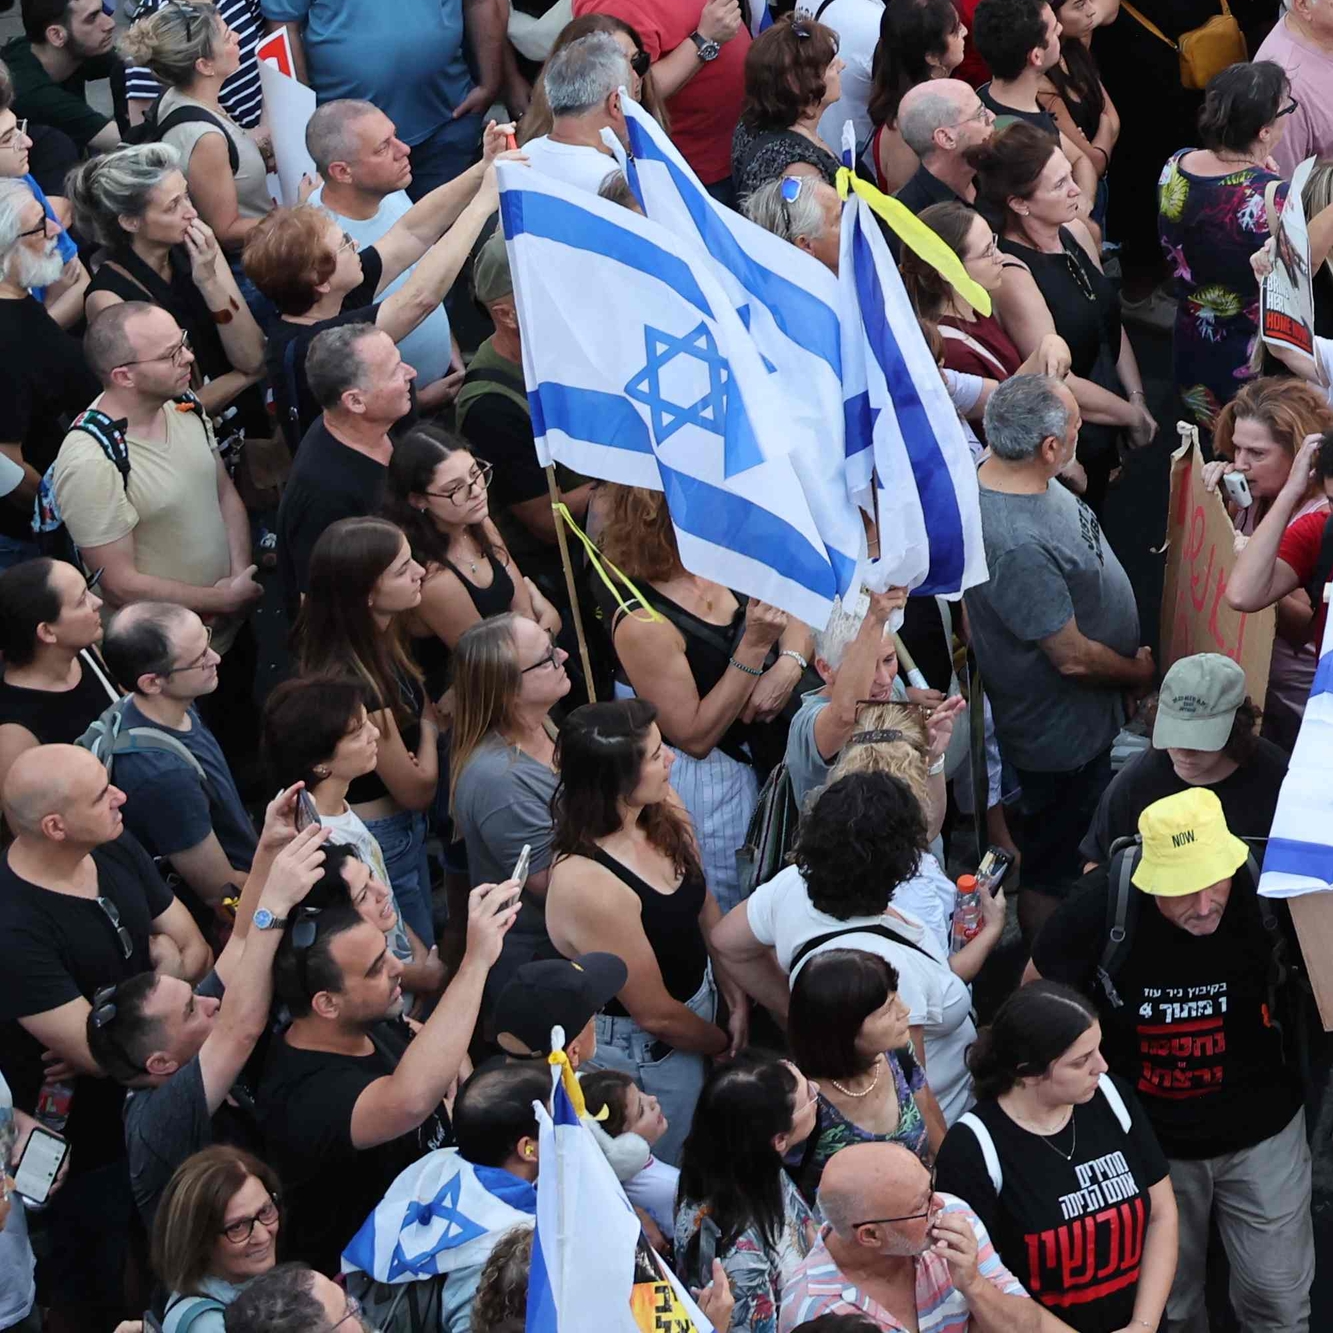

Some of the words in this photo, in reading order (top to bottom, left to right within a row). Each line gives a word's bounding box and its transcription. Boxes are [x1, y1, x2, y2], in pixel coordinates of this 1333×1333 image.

[1171, 828, 1198, 849] NOW.
[1143, 987, 1163, 999] עוז
[1166, 990, 1184, 999] ניר
[1187, 982, 1227, 999] בקיבוץ
[1139, 1002, 1152, 1019] 4
[1159, 999, 1214, 1024] מתוך
[1074, 1150, 1130, 1190] מחזירים
[1099, 1171, 1140, 1206] אותם
[1057, 1184, 1105, 1221] הביתה
[1023, 1196, 1145, 1291] עכשיו
